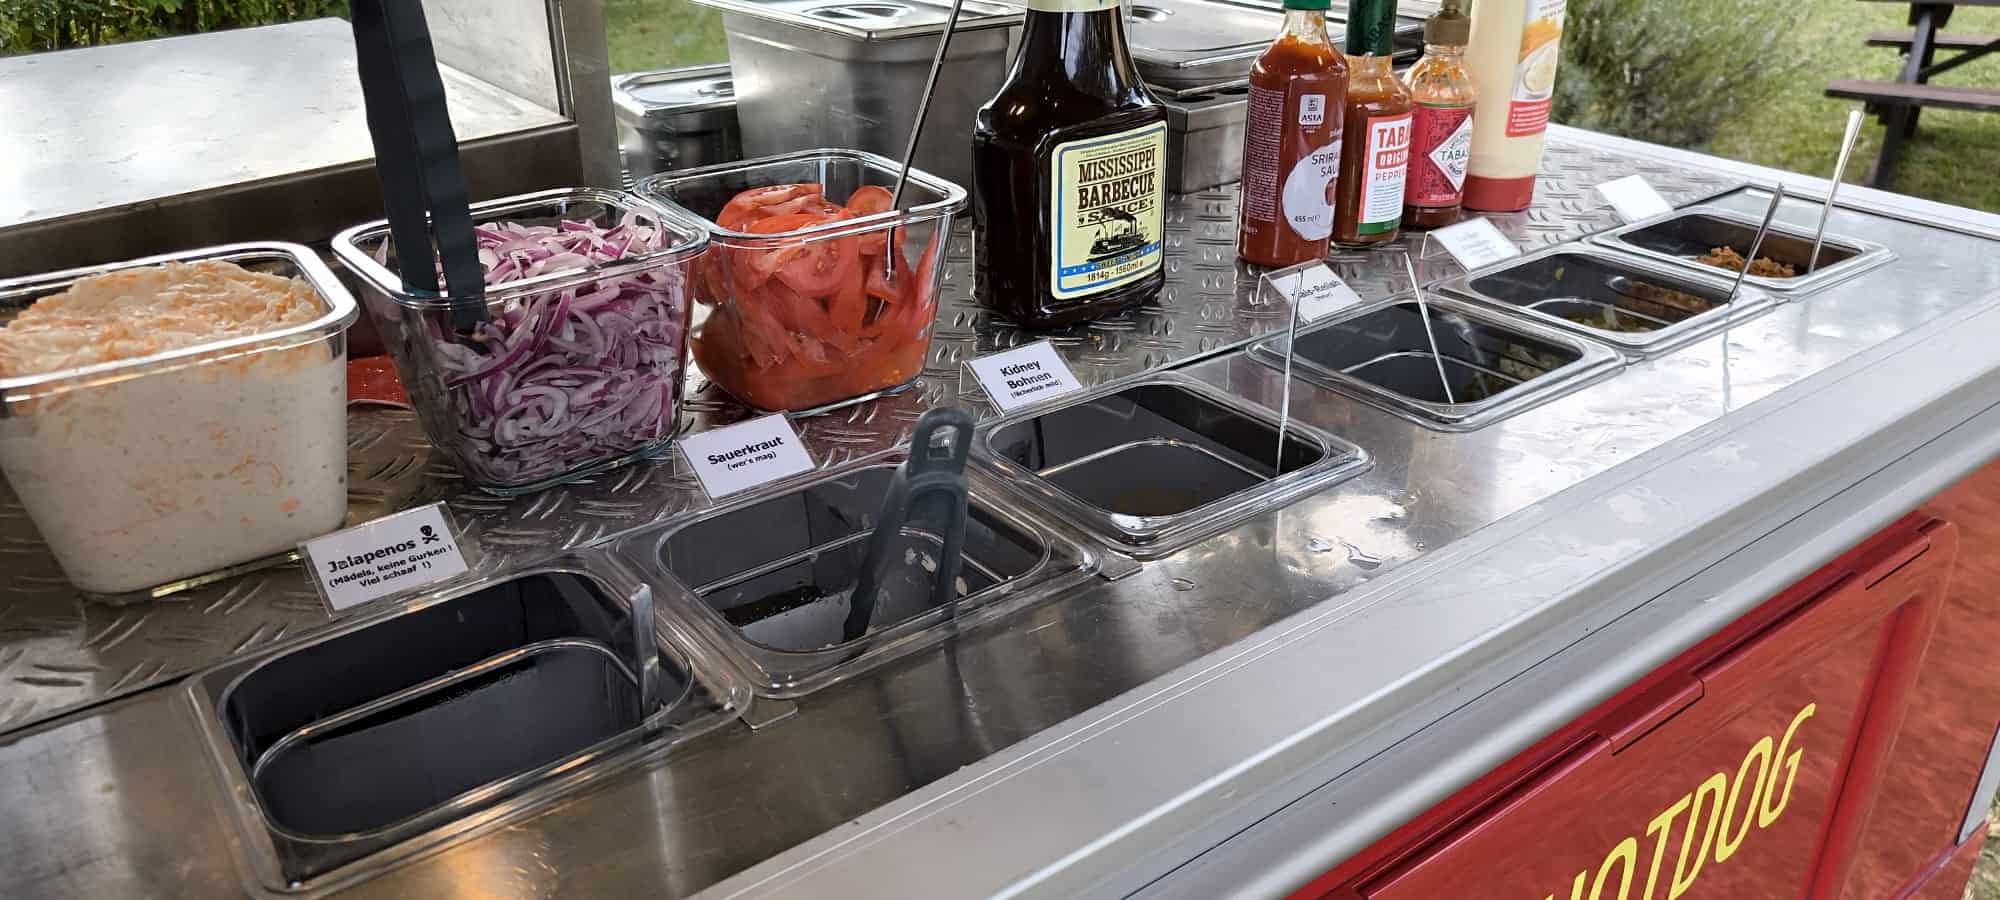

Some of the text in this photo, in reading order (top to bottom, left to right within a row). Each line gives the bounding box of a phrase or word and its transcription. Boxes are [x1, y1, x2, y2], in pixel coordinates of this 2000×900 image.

[1301, 113, 1322, 121] ASIA
[1079, 148, 1155, 183] MISSISSIPPI
[1079, 172, 1154, 209] BARBECUE
[1088, 270, 1109, 282] 1814g
[1000, 360, 1041, 377] Kidney
[1006, 371, 1052, 389] Bohnen
[707, 436, 784, 465] Sauerkraut
[754, 450, 777, 463] mag)
[328, 539, 416, 573] Jalapenos
[329, 568, 375, 588] (Mädels,
[377, 558, 406, 573] keine
[408, 547, 446, 563] Gurken
[359, 577, 380, 588] Viel
[1543, 702, 1816, 900] OTDOG
